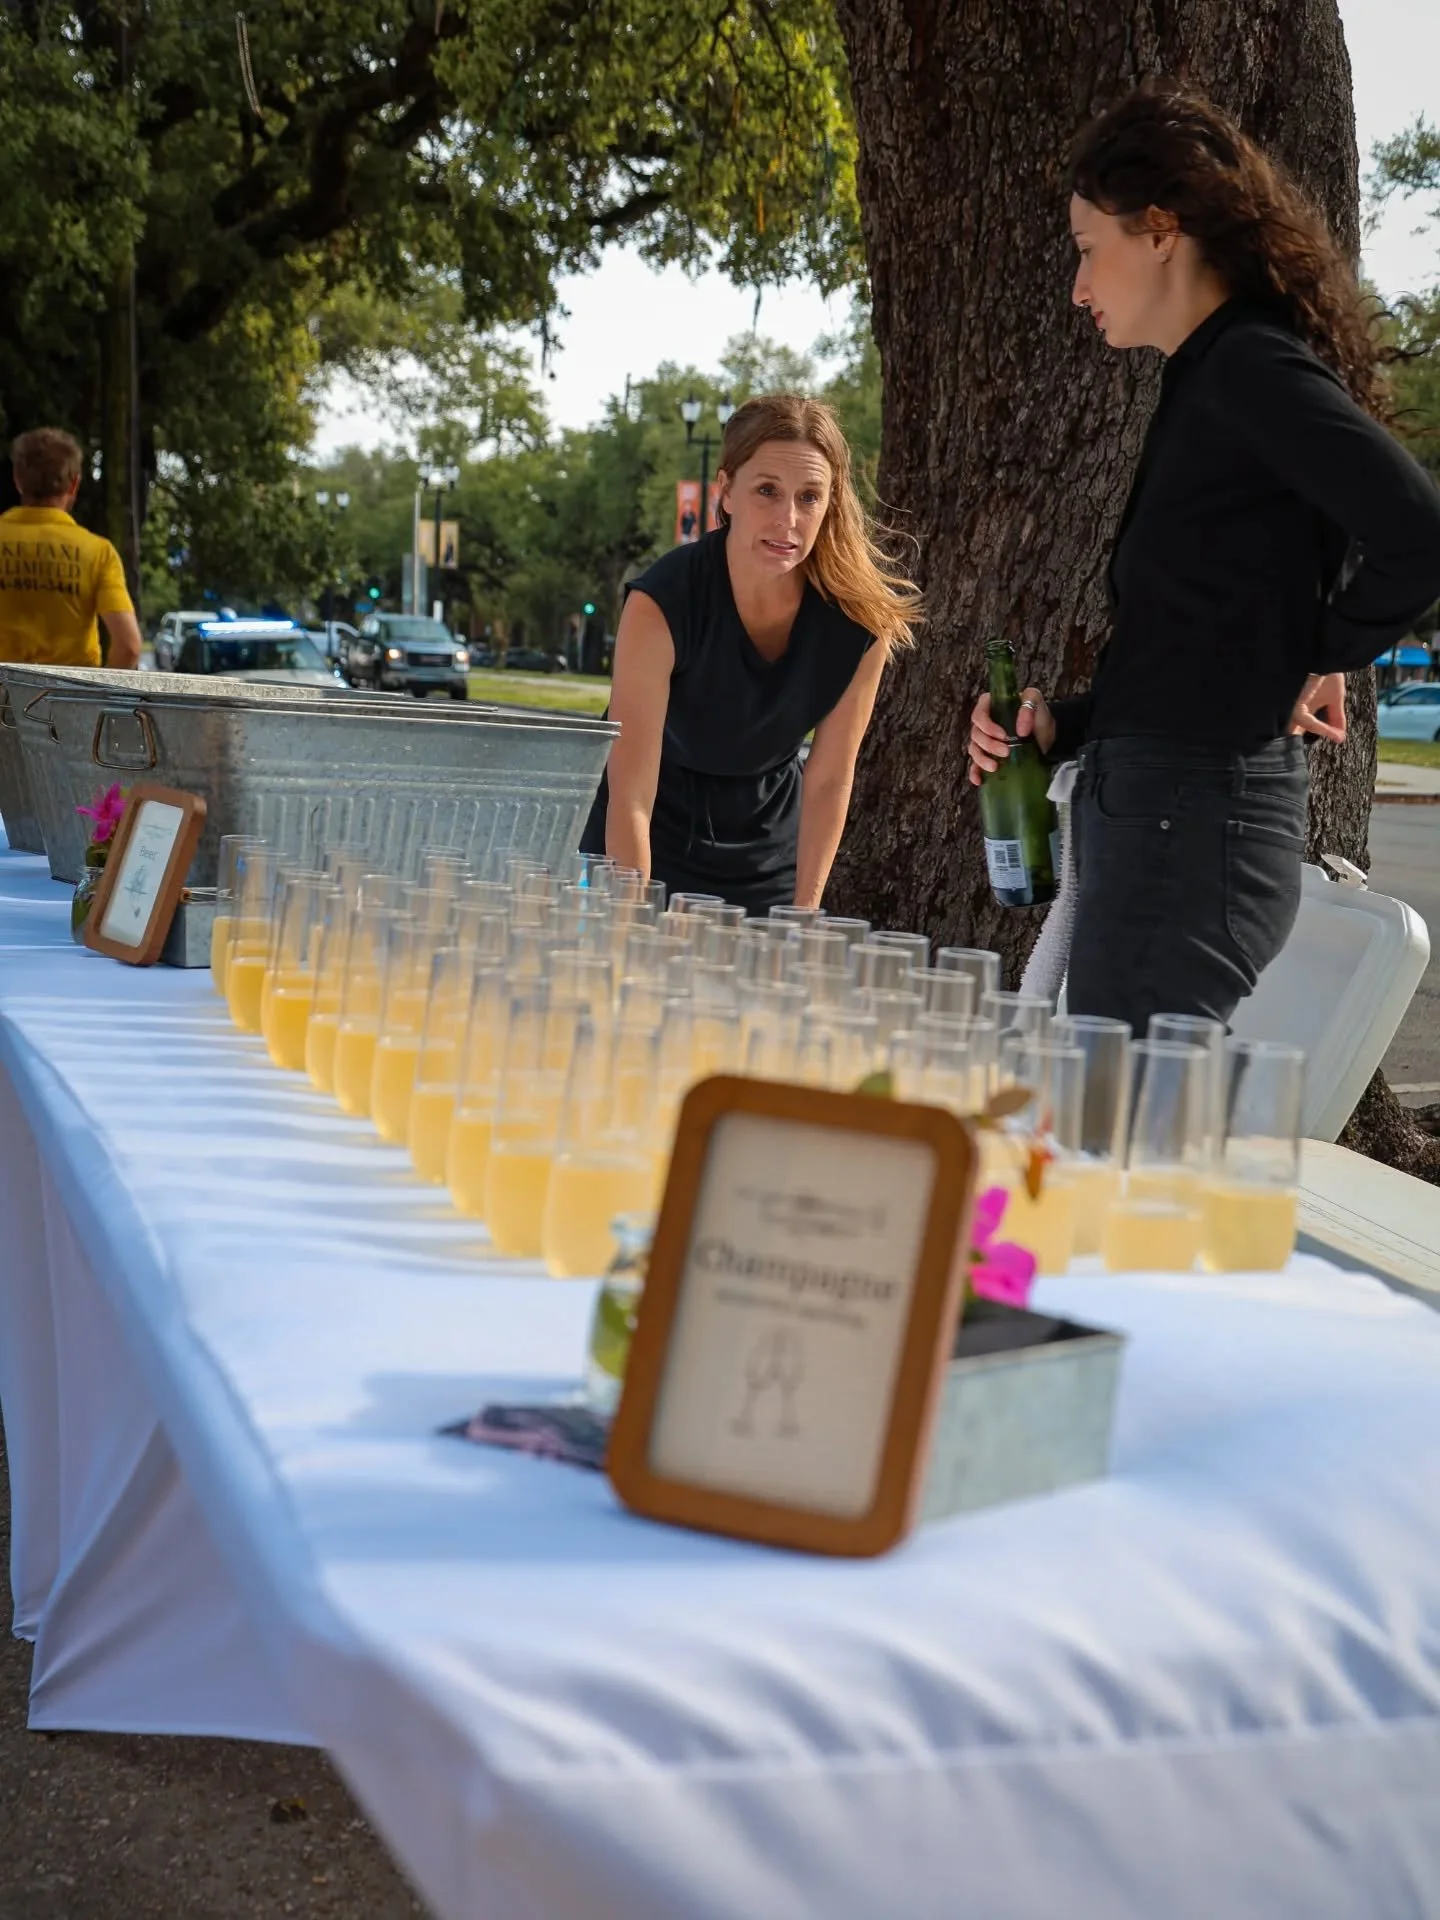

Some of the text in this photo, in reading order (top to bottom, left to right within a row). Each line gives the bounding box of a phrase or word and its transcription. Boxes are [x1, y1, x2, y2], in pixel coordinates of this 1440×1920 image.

[0, 558, 81, 577] LIMITED
[139, 845, 158, 861] Beer
[693, 1237, 899, 1301] Champagne
